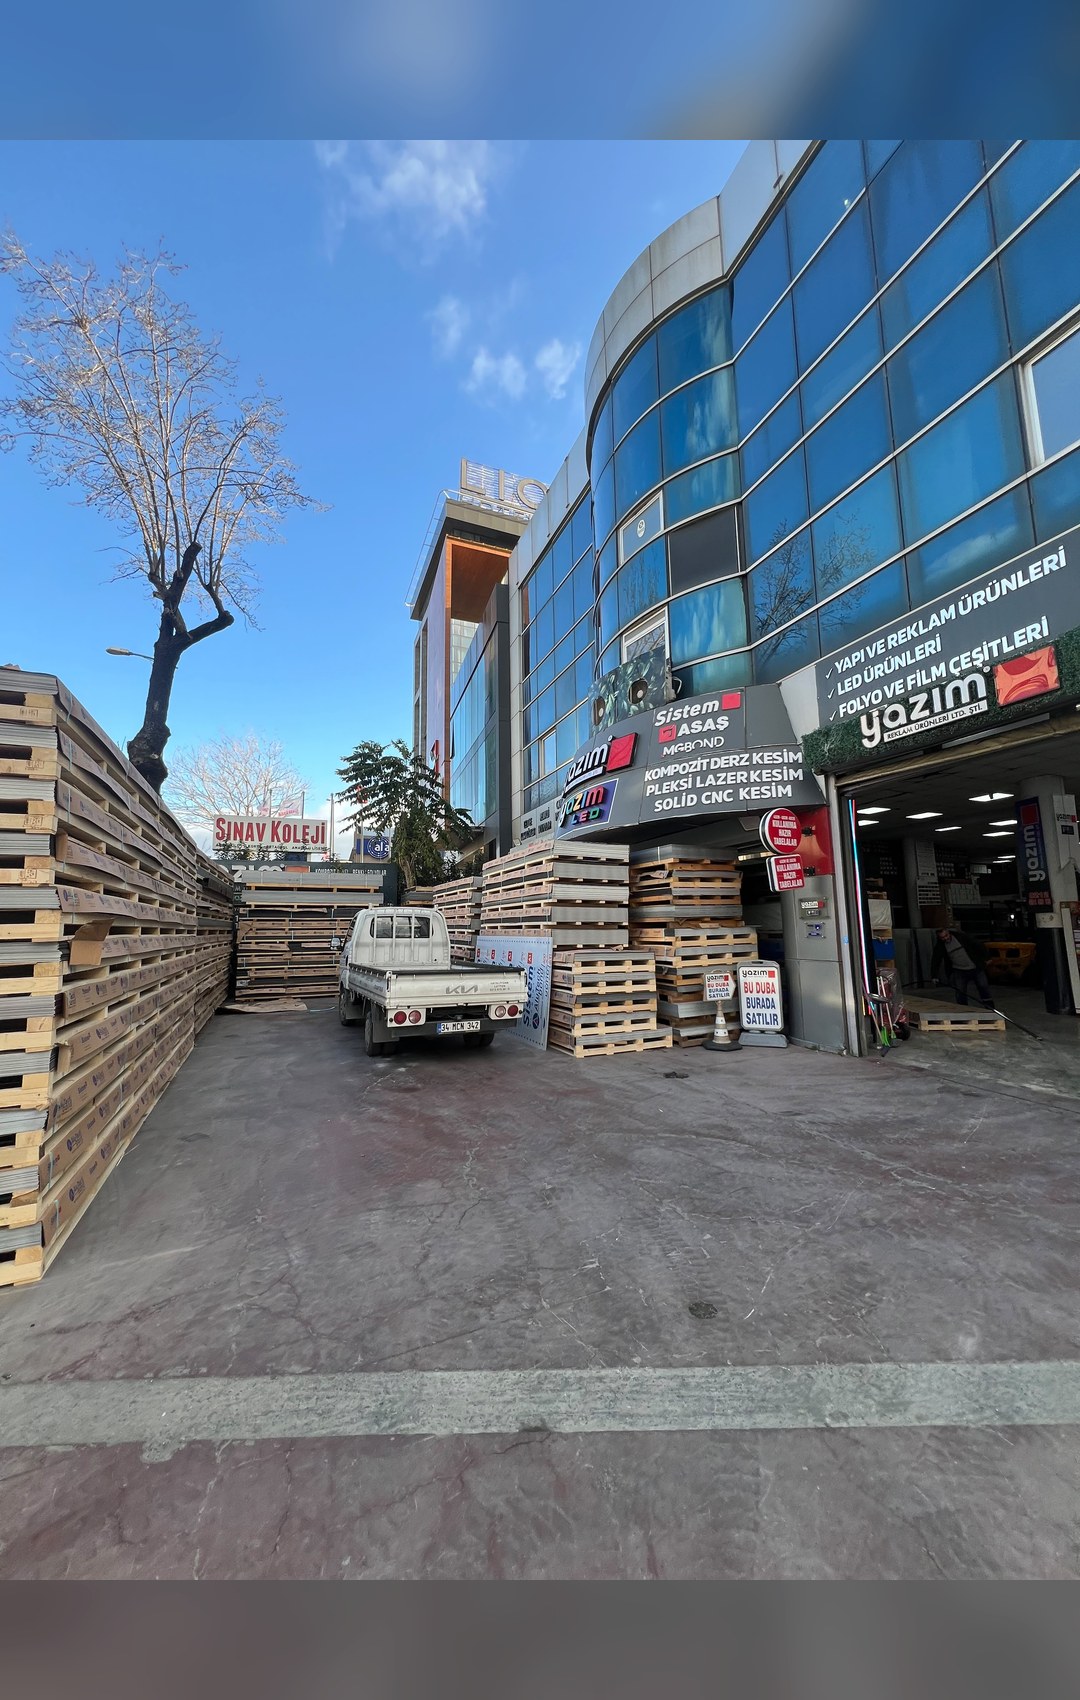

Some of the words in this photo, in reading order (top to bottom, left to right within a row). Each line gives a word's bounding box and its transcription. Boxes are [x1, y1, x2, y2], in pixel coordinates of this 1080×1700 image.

[834, 648, 866, 675] YAPI
[866, 641, 886, 662] VE
[887, 603, 957, 651] REKLAM
[957, 545, 1067, 617] ÜRÜNLERİ
[837, 673, 863, 697] LED
[863, 633, 942, 685] ÜRÜNLERİ
[838, 690, 883, 720] FOLYO
[884, 678, 906, 700] VE
[907, 660, 947, 692] FİLM
[949, 615, 1050, 678] ÇEŞİTLERİ
[654, 698, 720, 728] Sistem
[860, 672, 987, 749] yazım
[887, 725, 914, 740] REKLAM
[914, 713, 951, 732] ÜRÜNLERİ
[951, 709, 967, 721] LTD.
[968, 703, 984, 717] ŞTİ.
[677, 715, 730, 738] ASAŞ
[663, 735, 725, 757] MGBOND
[644, 756, 710, 783] KOMPOZİT
[711, 752, 750, 773] DERZ
[752, 748, 803, 766] KESİM
[645, 773, 694, 798] PLEKSİ
[696, 769, 749, 789] LAZER
[750, 765, 804, 784] KESİM
[654, 791, 698, 814] SOLİD
[701, 787, 734, 805] CNC
[739, 783, 793, 801] KESİM
[571, 807, 600, 826] LED
[215, 817, 267, 841] SINAV
[271, 820, 326, 845] KOLEJİ
[773, 837, 797, 846] TABELALAR
[779, 879, 803, 888] TABELALAR
[743, 981, 754, 994] BU
[756, 981, 776, 994] DUBA
[746, 997, 776, 1010] BURADA
[441, 1023, 450, 1032] 34
[467, 1021, 479, 1030] 342
[745, 1012, 779, 1026] SATILIR
